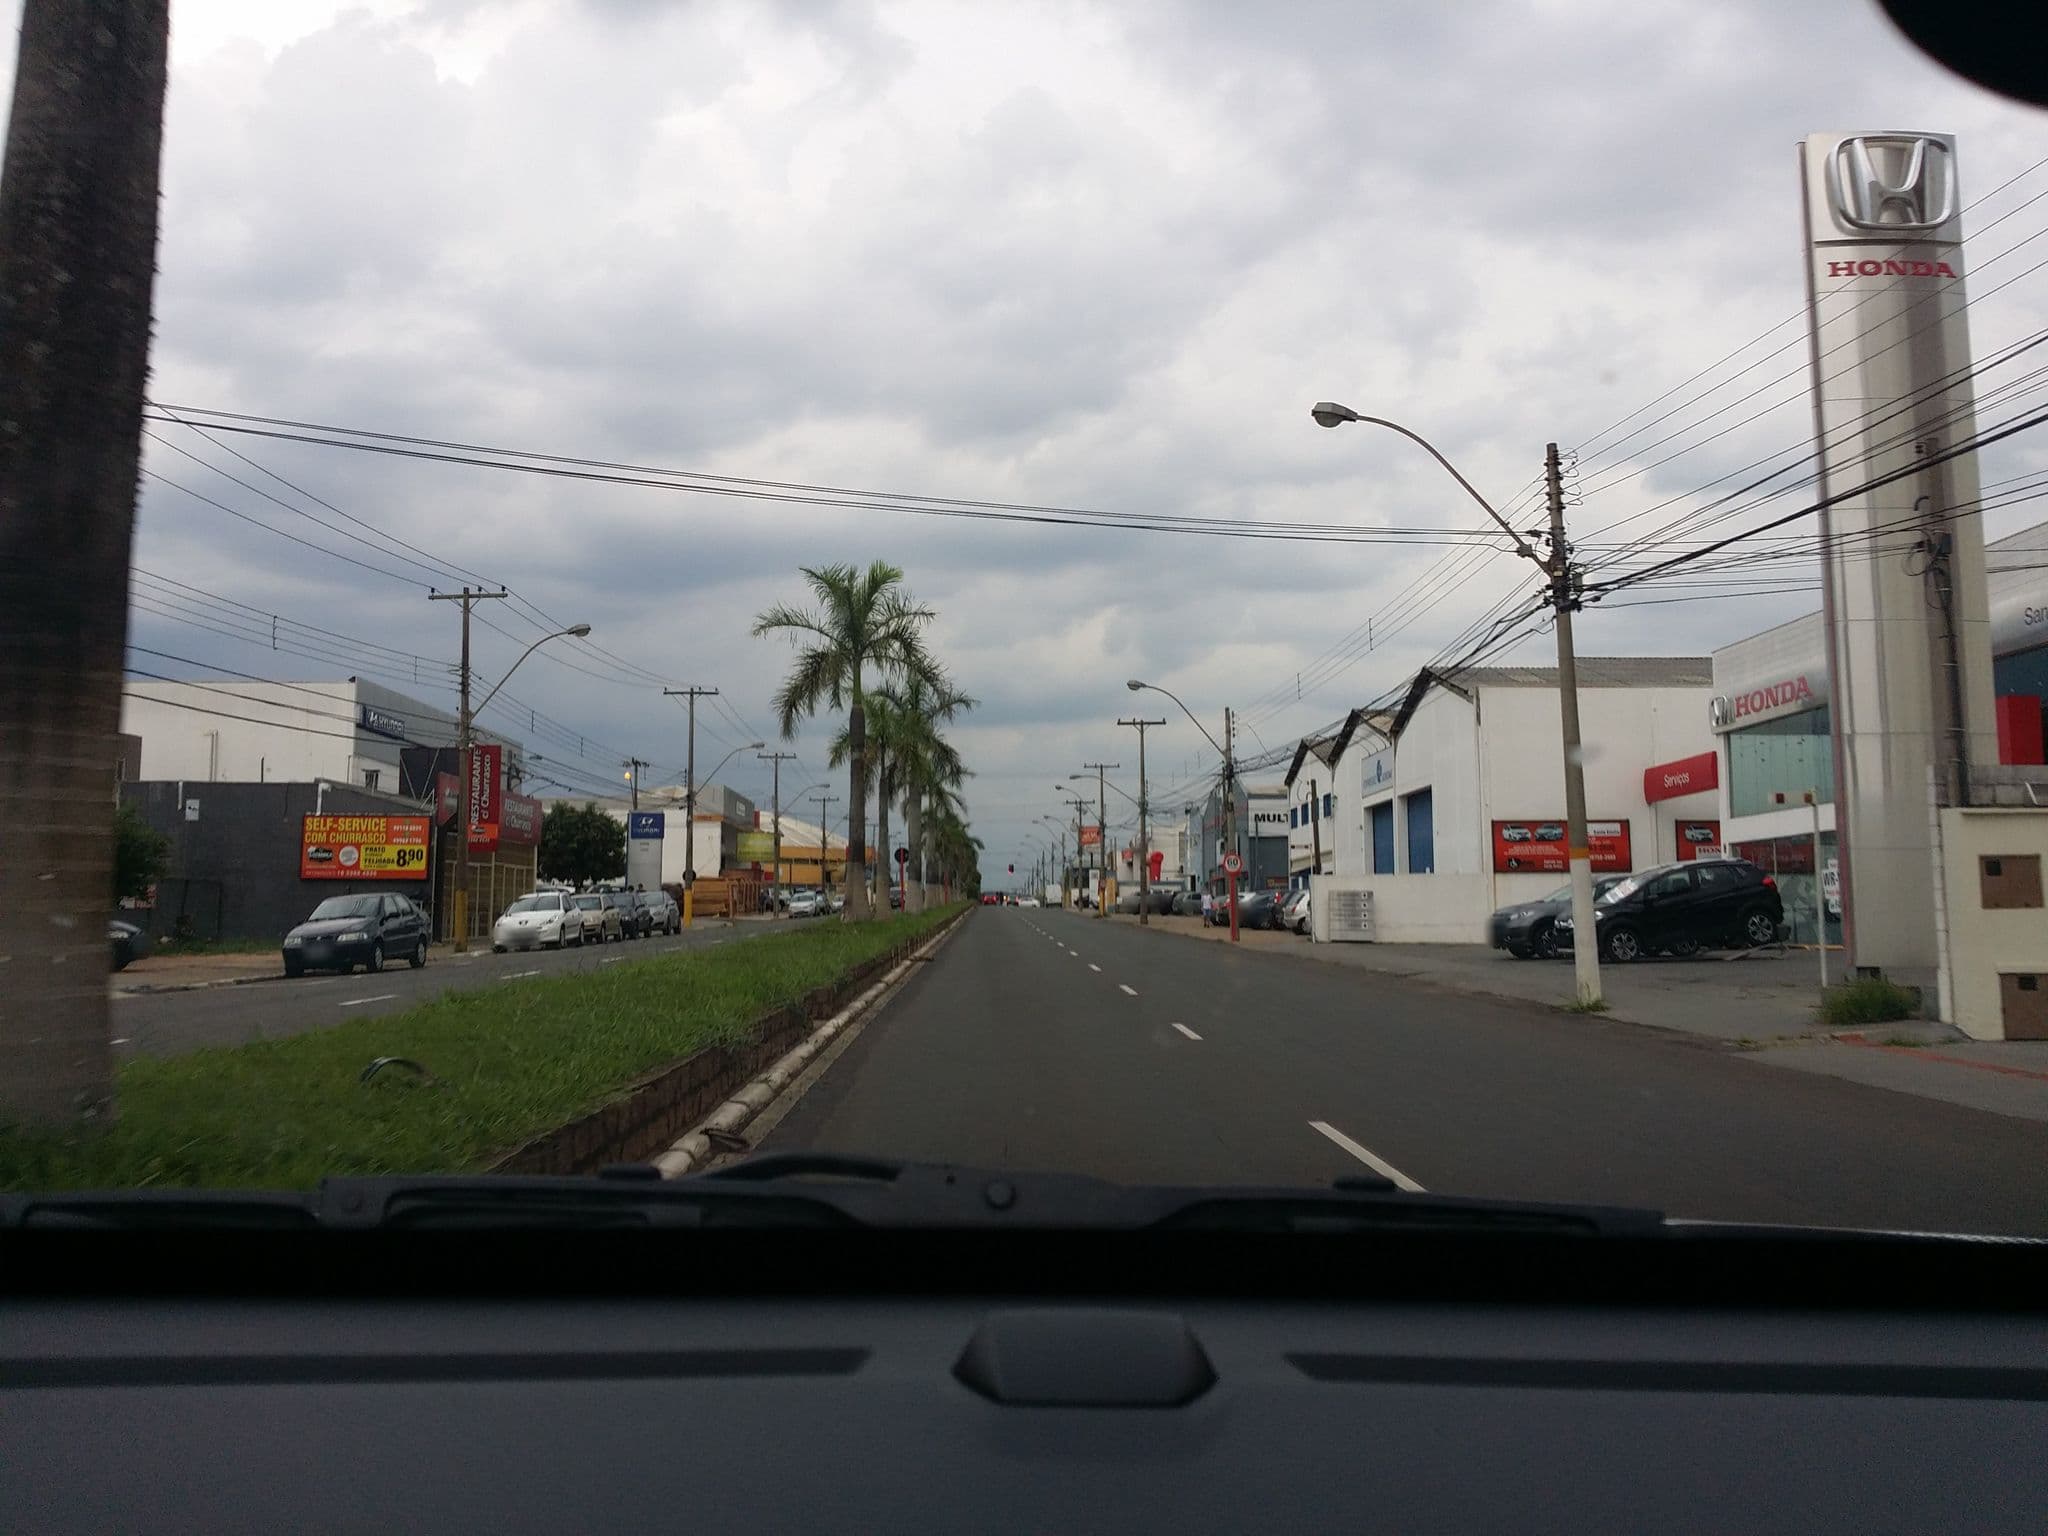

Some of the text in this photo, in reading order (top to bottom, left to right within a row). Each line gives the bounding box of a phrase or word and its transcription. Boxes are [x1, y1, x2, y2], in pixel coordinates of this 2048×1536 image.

[1827, 259, 1957, 279] HONDA
[1734, 674, 1814, 718] HONDA
[470, 746, 482, 825] RESTAURANTE
[1664, 772, 1690, 788] Serviços
[305, 817, 387, 832] SELF-SERVICE
[304, 832, 327, 844] COM
[329, 832, 387, 844] CHURRASCO
[396, 848, 424, 868] 8,90
[1226, 857, 1239, 866] 60
